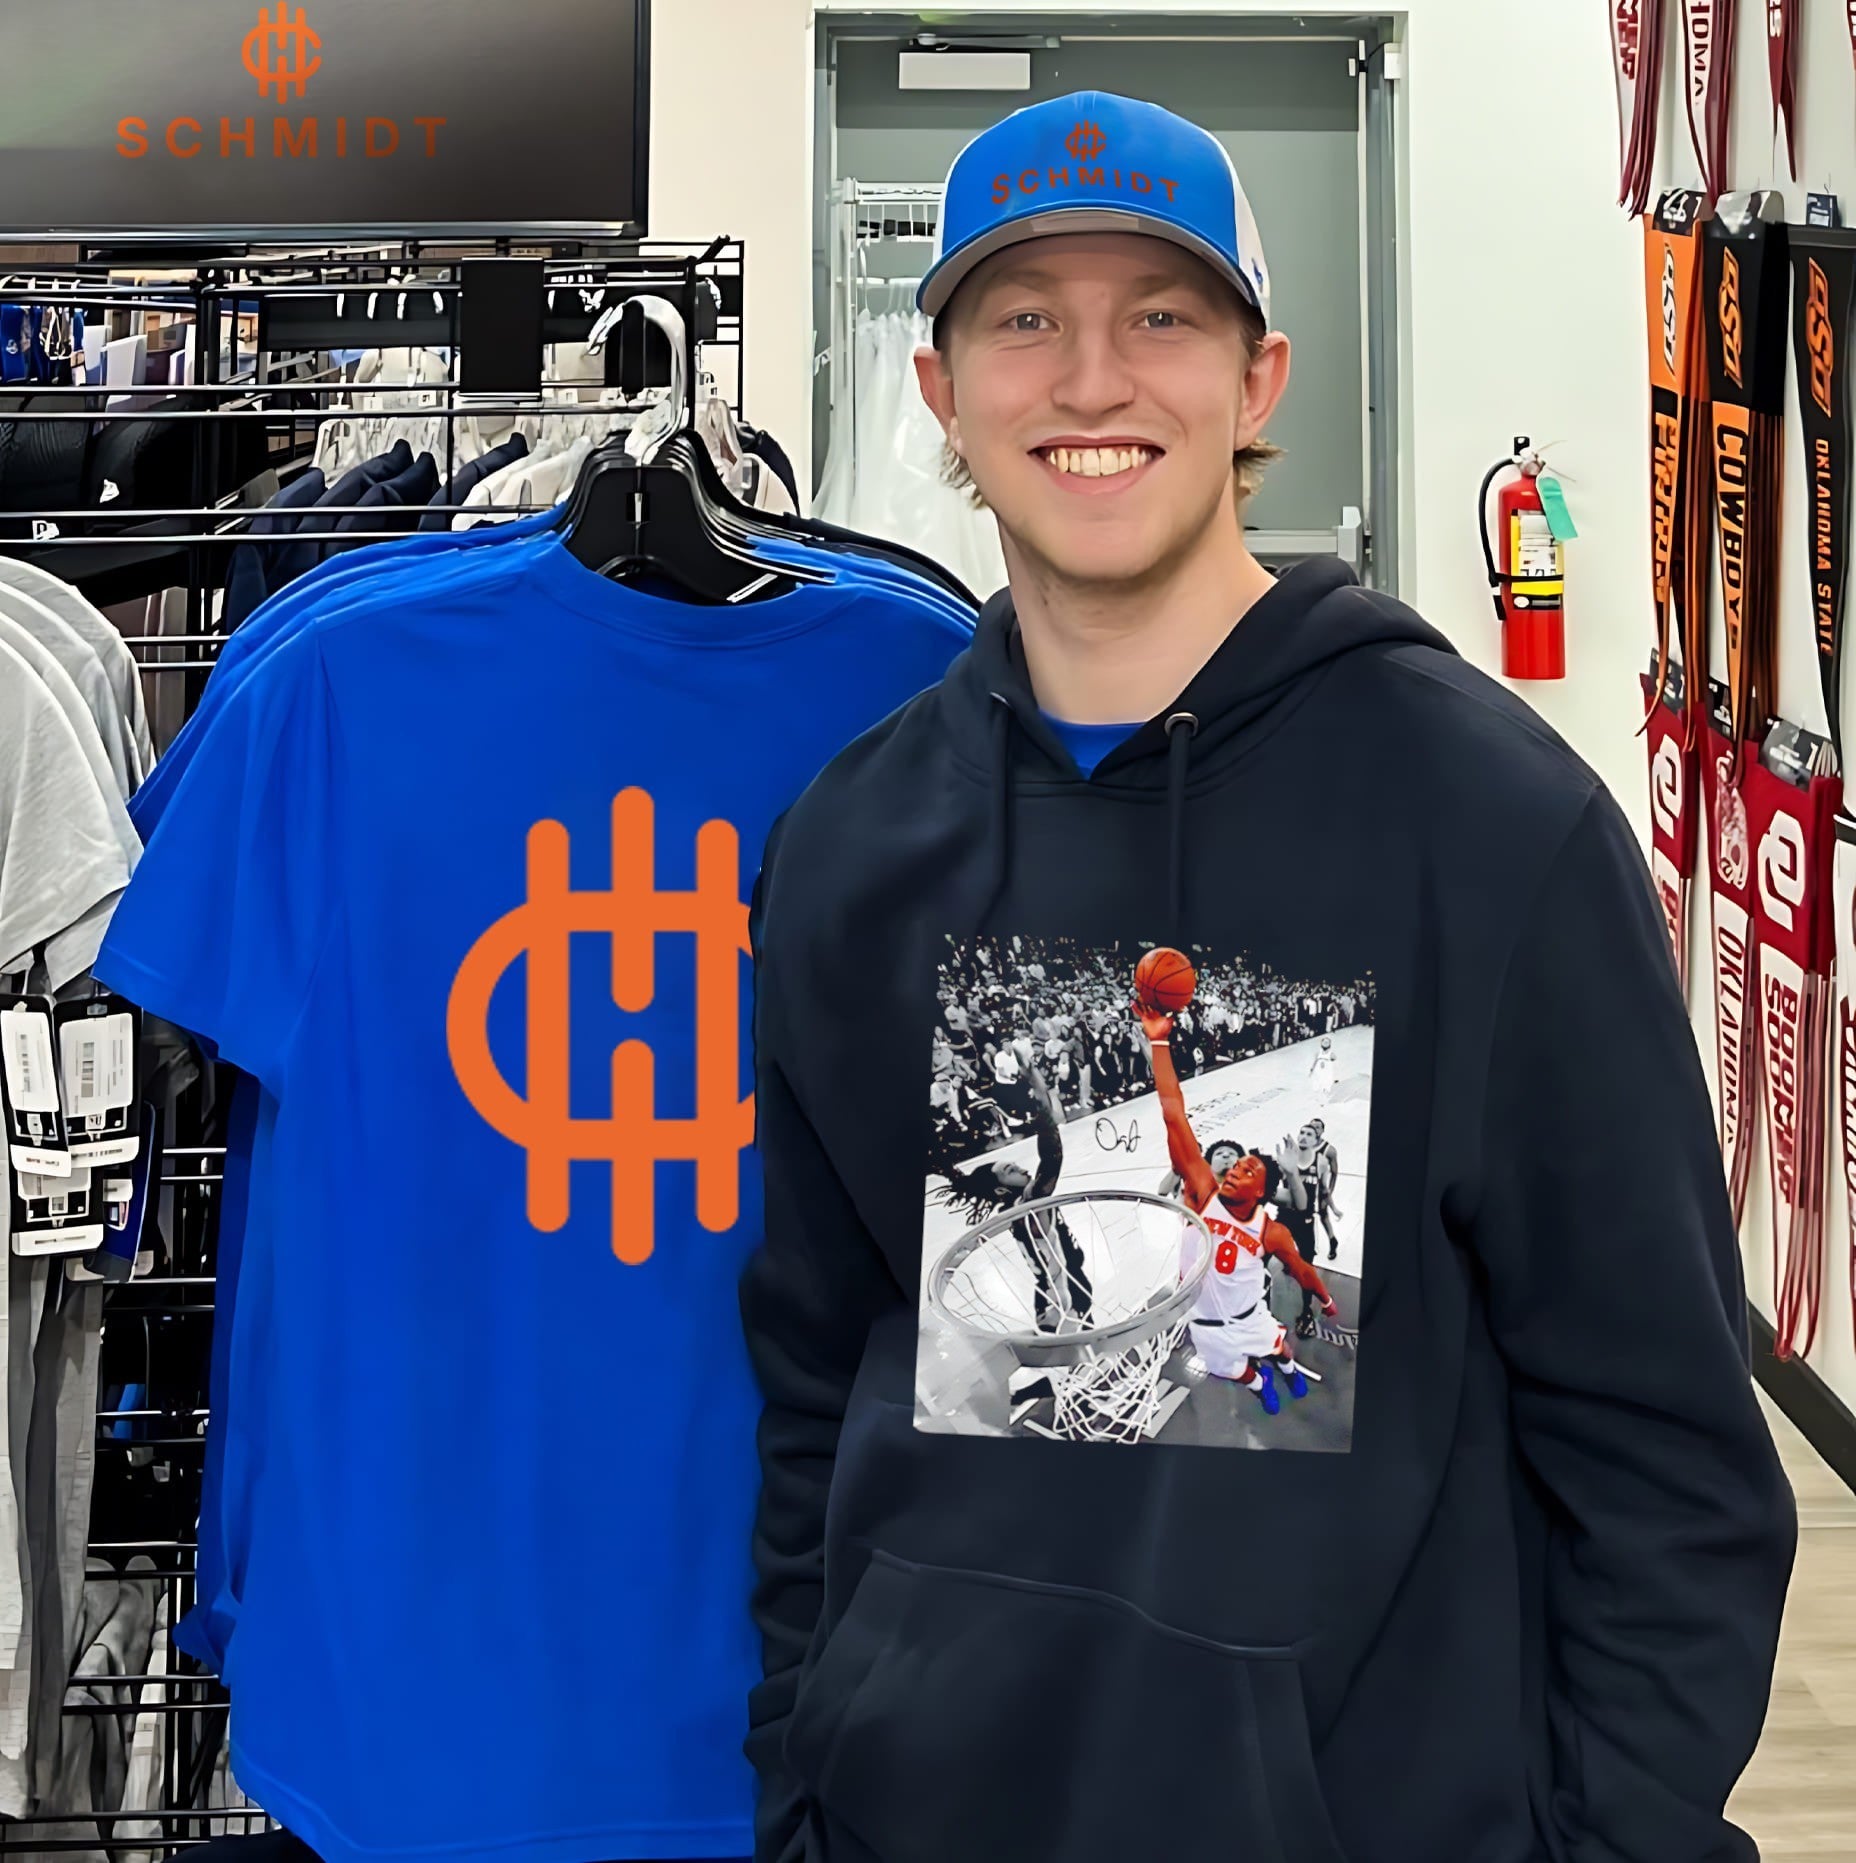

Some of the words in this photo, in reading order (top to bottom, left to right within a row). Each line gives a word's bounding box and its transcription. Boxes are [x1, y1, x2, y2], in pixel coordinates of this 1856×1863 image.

[115, 116, 447, 158] SCHMIDT
[991, 167, 1179, 205] SCHMIDT
[1816, 438, 1832, 570] OKLAHOMA
[1214, 1240, 1239, 1275] 8
